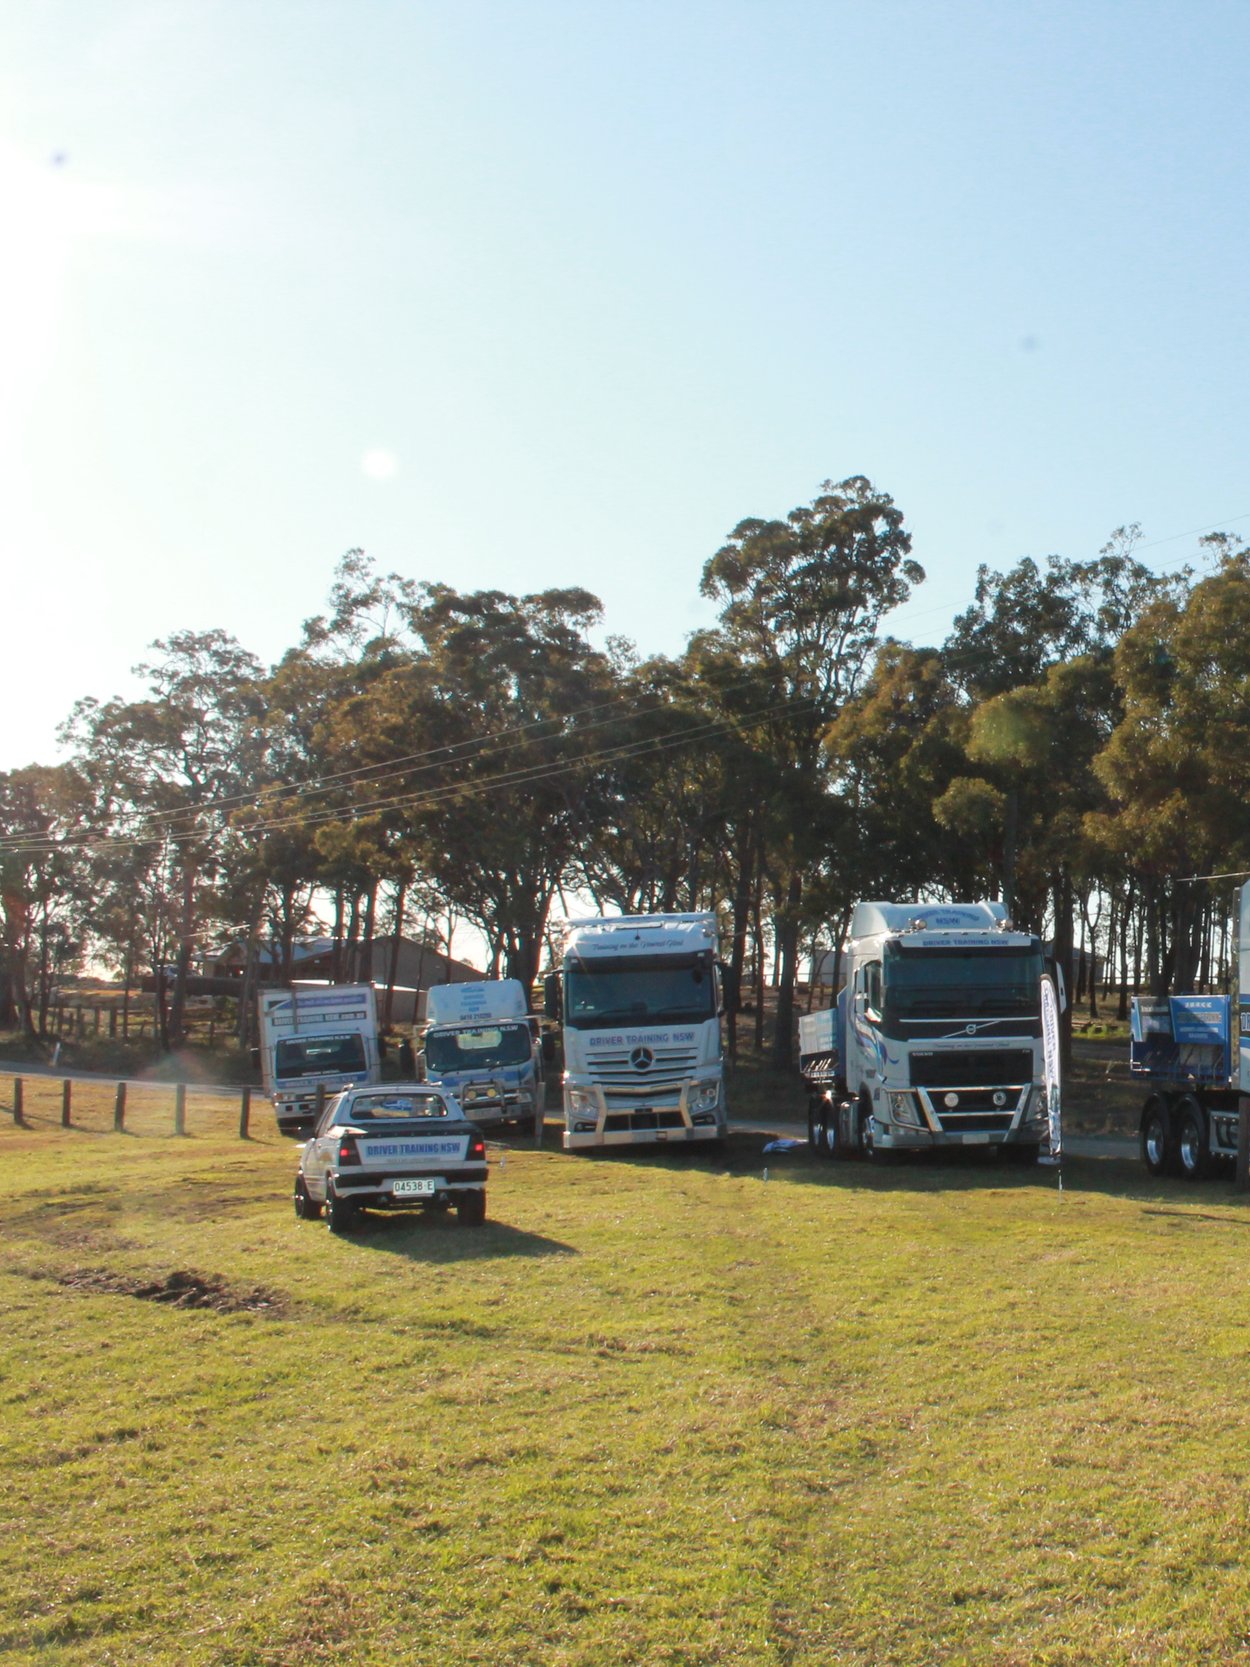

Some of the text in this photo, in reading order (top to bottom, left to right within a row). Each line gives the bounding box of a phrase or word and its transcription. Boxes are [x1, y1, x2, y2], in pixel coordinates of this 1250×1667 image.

[590, 1031, 696, 1047] DRIVER TRAINING NSW
[366, 1142, 461, 1157] DRIVER TRAINING NSW
[394, 1181, 423, 1192] 04538
